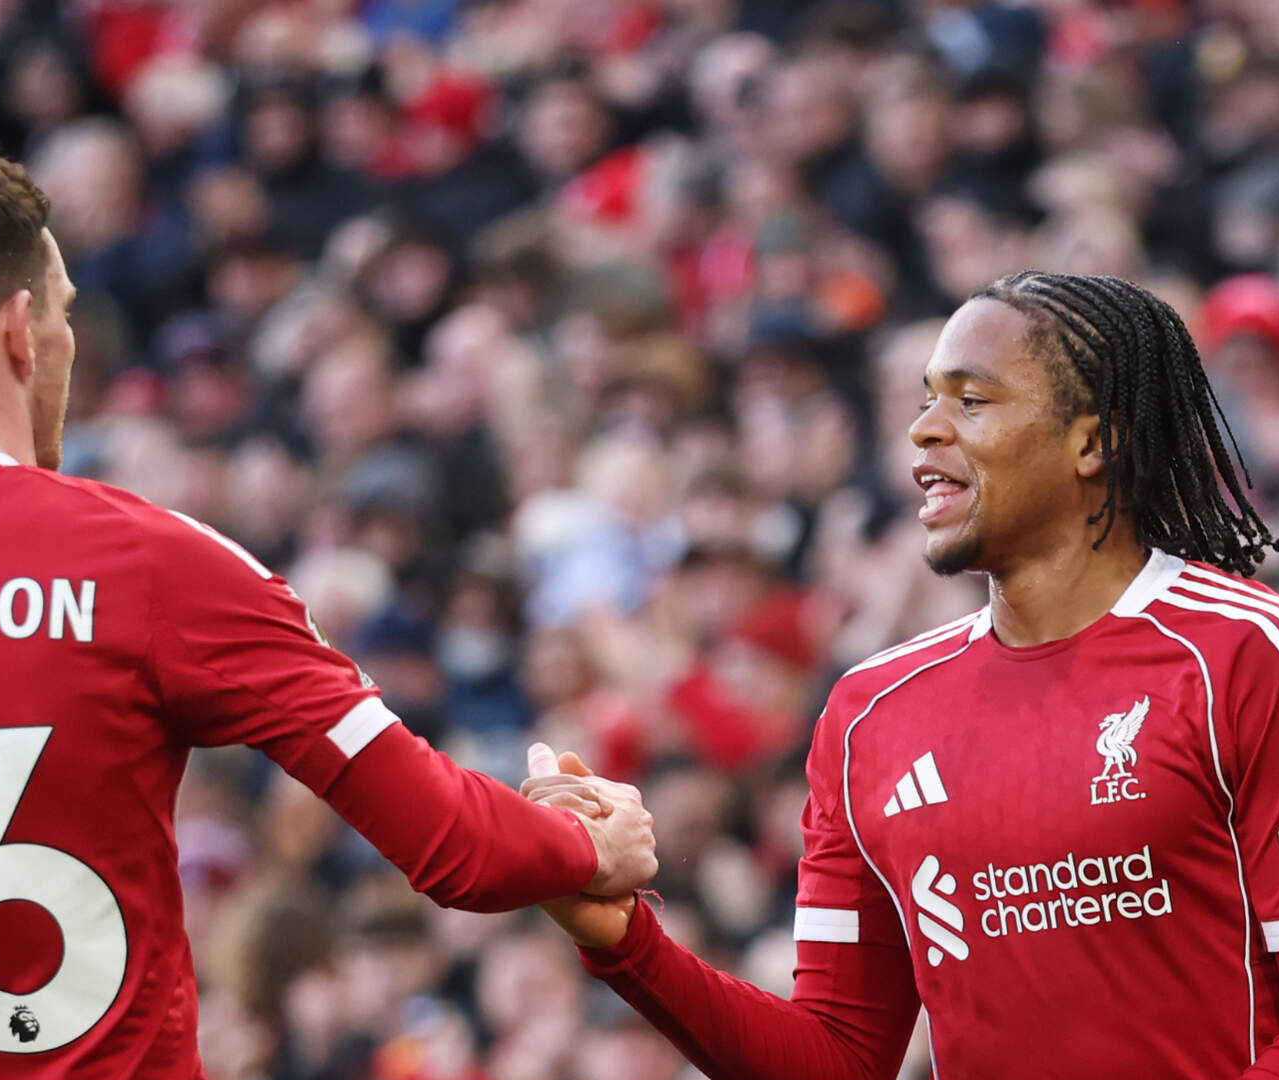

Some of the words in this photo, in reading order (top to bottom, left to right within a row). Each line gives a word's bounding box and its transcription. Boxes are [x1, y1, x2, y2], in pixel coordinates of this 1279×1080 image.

[1090, 778, 1147, 805] L.F.C.
[972, 845, 1153, 901] standard
[981, 879, 1172, 937] chartered
